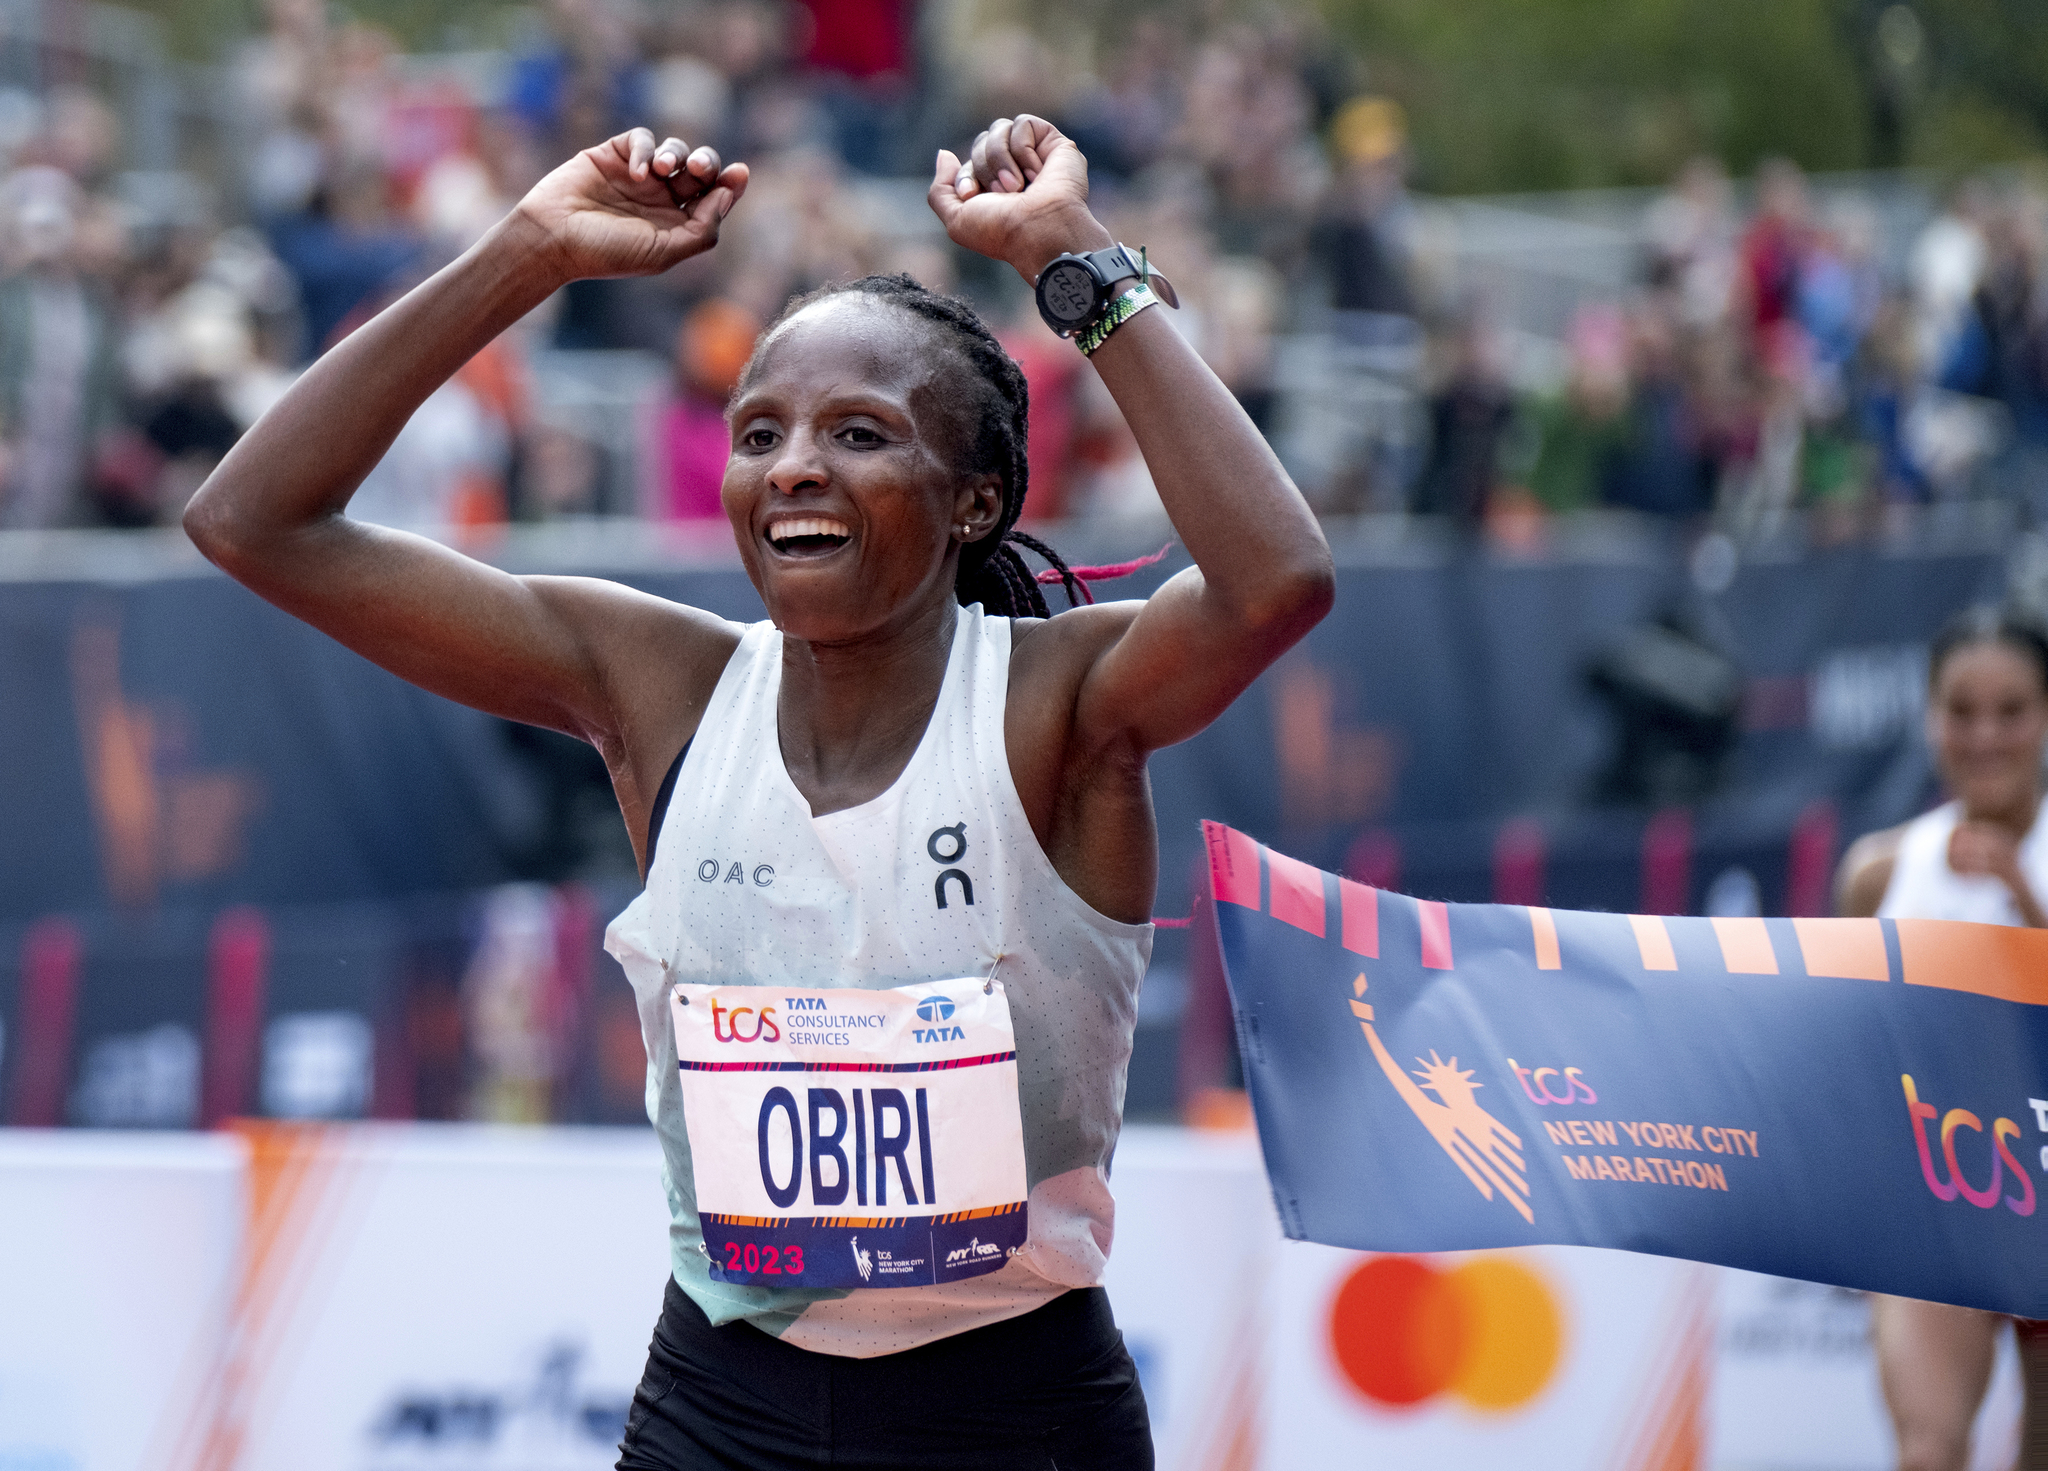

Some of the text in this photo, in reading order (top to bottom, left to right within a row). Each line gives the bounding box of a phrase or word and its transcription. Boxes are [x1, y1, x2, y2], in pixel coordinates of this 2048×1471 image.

[1053, 270, 1088, 311] 27:22
[698, 858, 775, 887] OAC
[711, 998, 781, 1043] tcs
[785, 998, 827, 1010] TATA
[787, 1015, 886, 1028] CONSULTANCY
[789, 1032, 850, 1045] SERVICES
[912, 1026, 966, 1043] TATA
[1507, 1058, 1598, 1105] tcs
[757, 1086, 937, 1208] OBIRI
[1542, 1120, 1760, 1157] NEW YORK CITY
[1901, 1073, 2037, 1217] tcs
[1562, 1155, 1729, 1191] MARATHON
[725, 1242, 805, 1274] 2023
[877, 1250, 892, 1260] tcs
